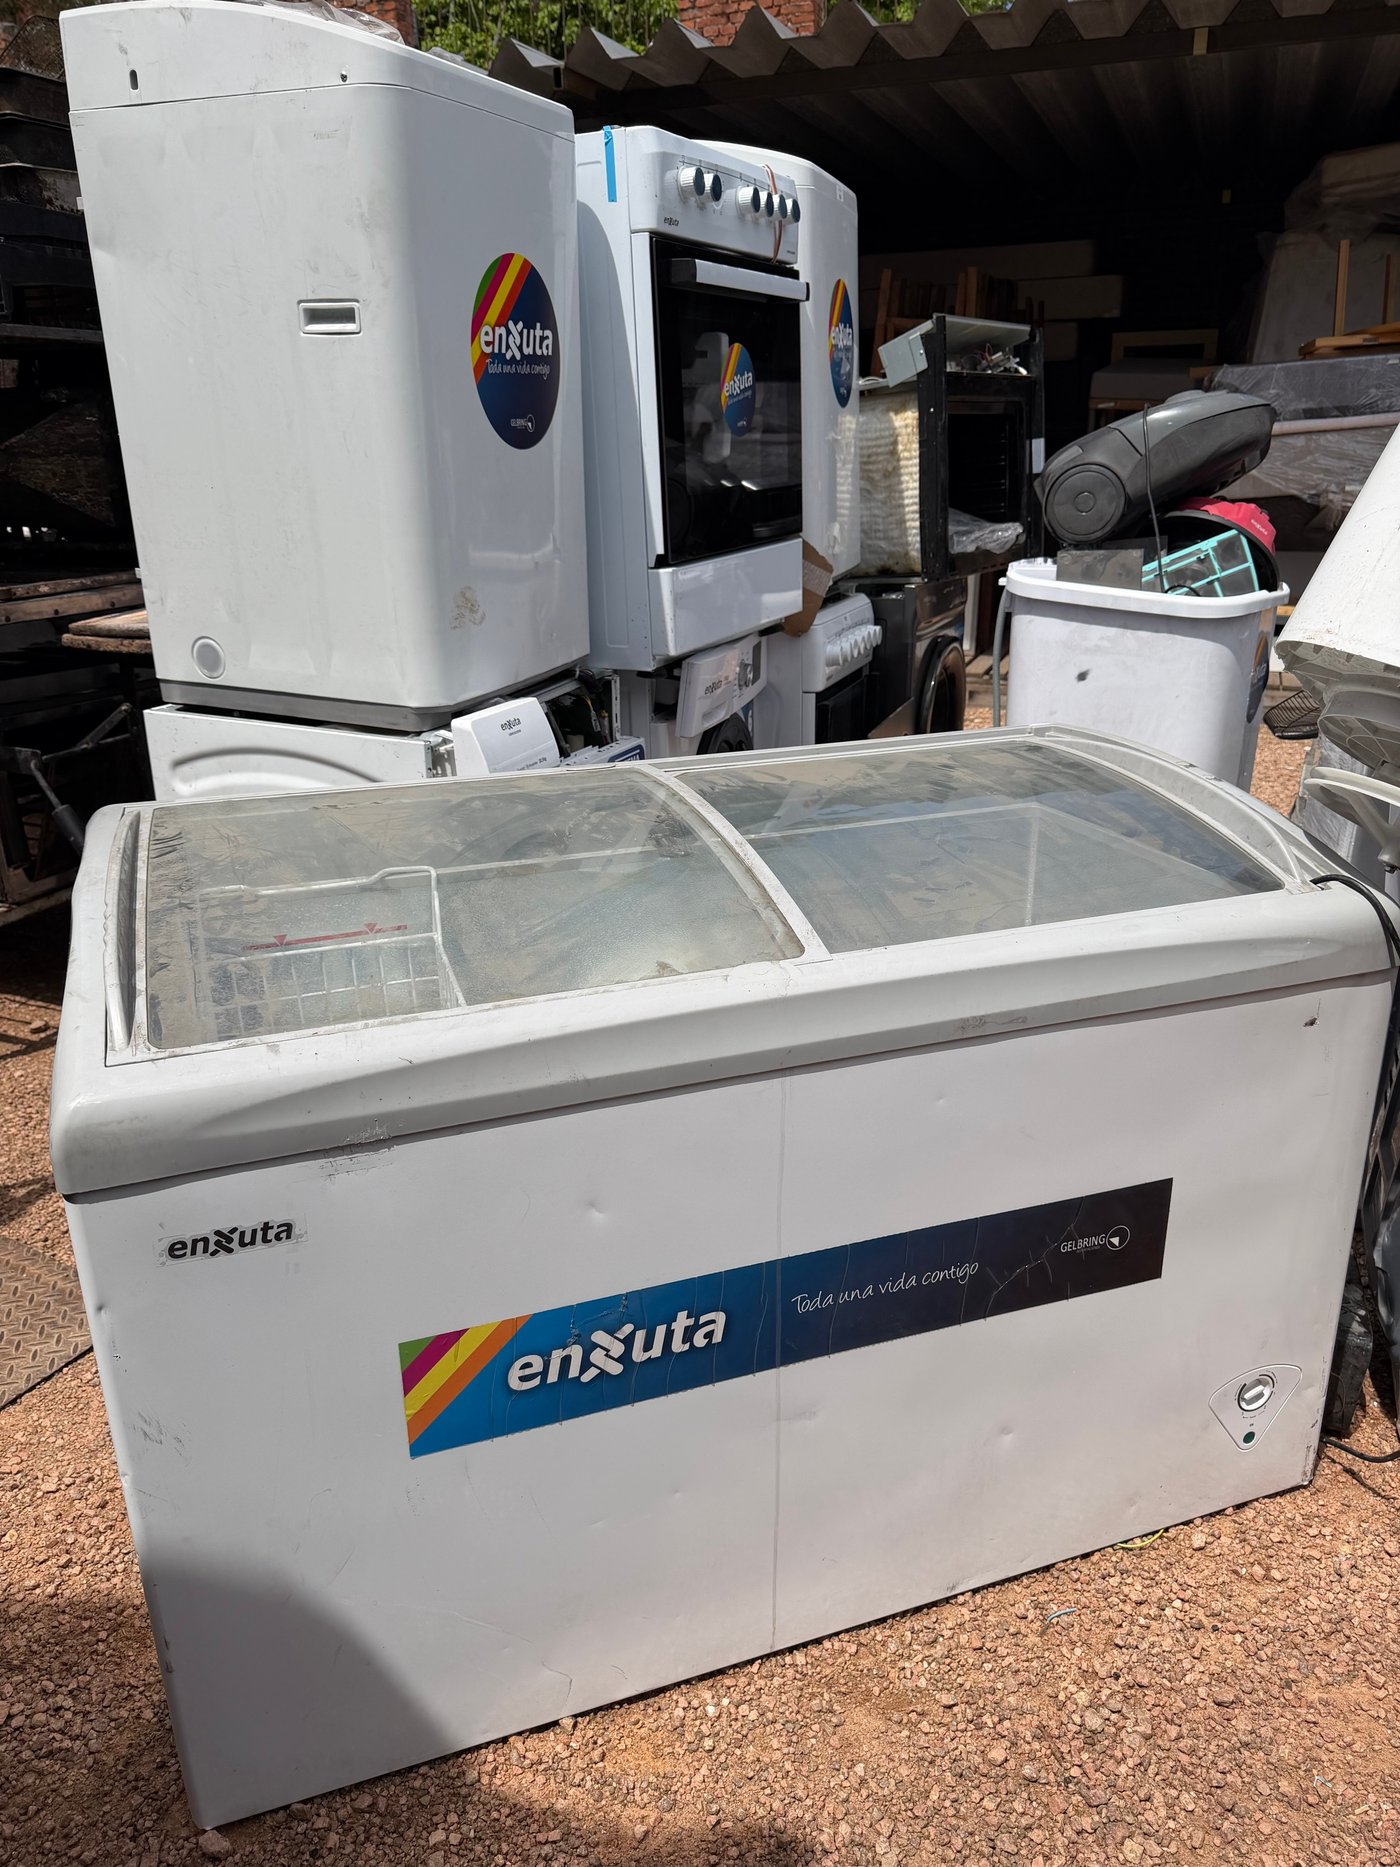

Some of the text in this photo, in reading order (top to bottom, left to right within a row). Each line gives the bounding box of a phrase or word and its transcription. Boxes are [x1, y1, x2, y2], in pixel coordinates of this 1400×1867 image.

[480, 320, 553, 360] enxuta
[167, 1221, 294, 1259] enxuta
[1060, 1234, 1106, 1253] GELBRING
[792, 1262, 979, 1314] Toda una vida contigo
[507, 1310, 727, 1392] enxuta
